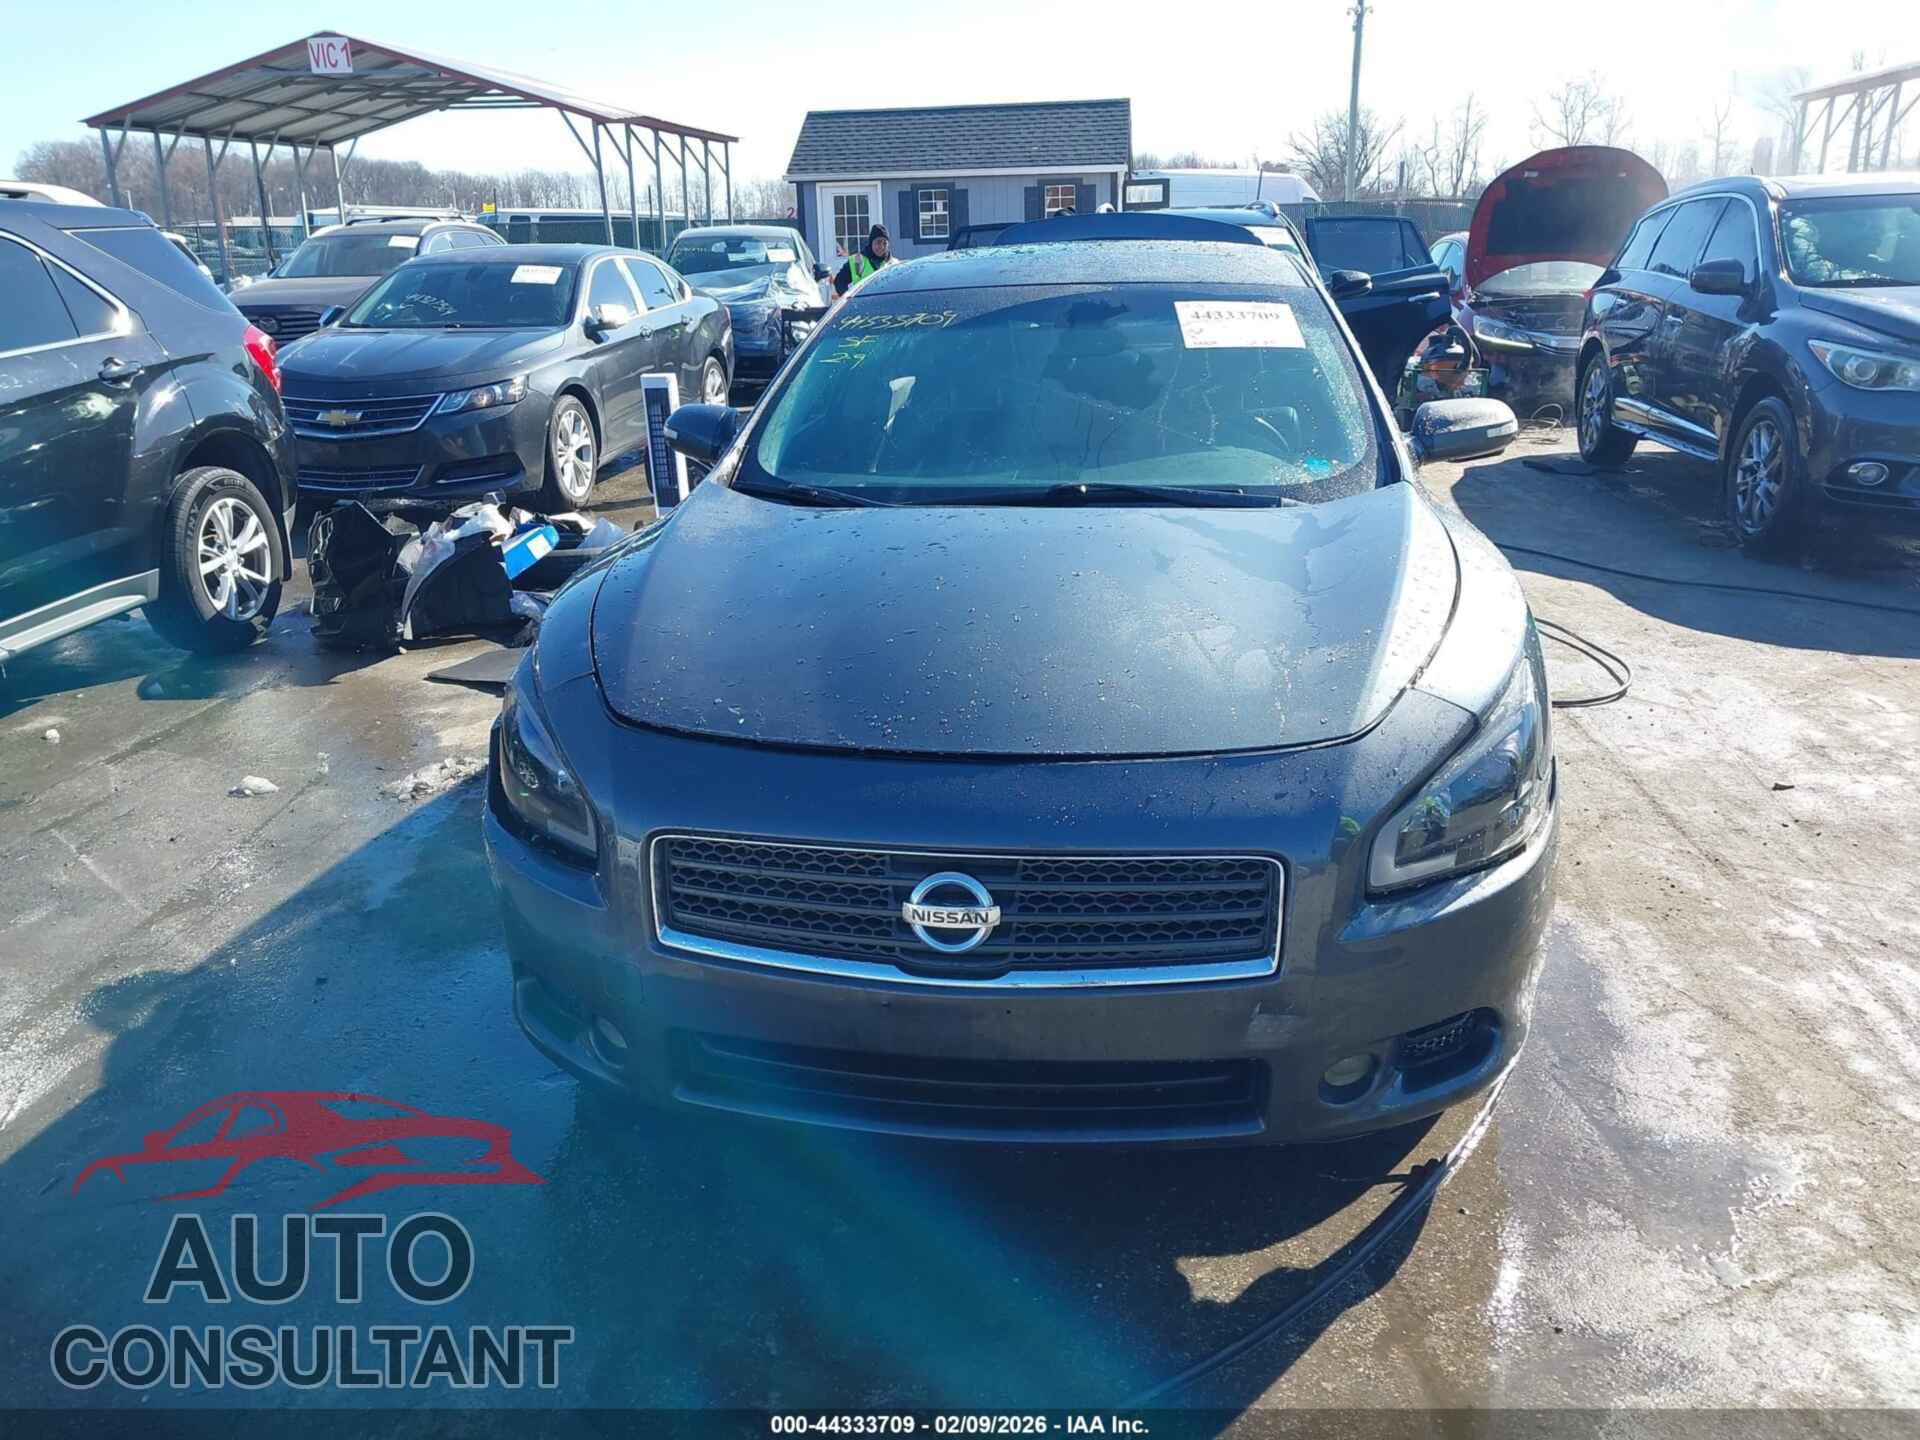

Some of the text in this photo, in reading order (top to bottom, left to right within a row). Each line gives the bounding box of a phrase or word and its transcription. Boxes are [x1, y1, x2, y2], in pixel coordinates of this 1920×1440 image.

[308, 42, 351, 68] VIC 1
[1190, 311, 1280, 320] 44333709
[911, 908, 989, 924] NISSAN
